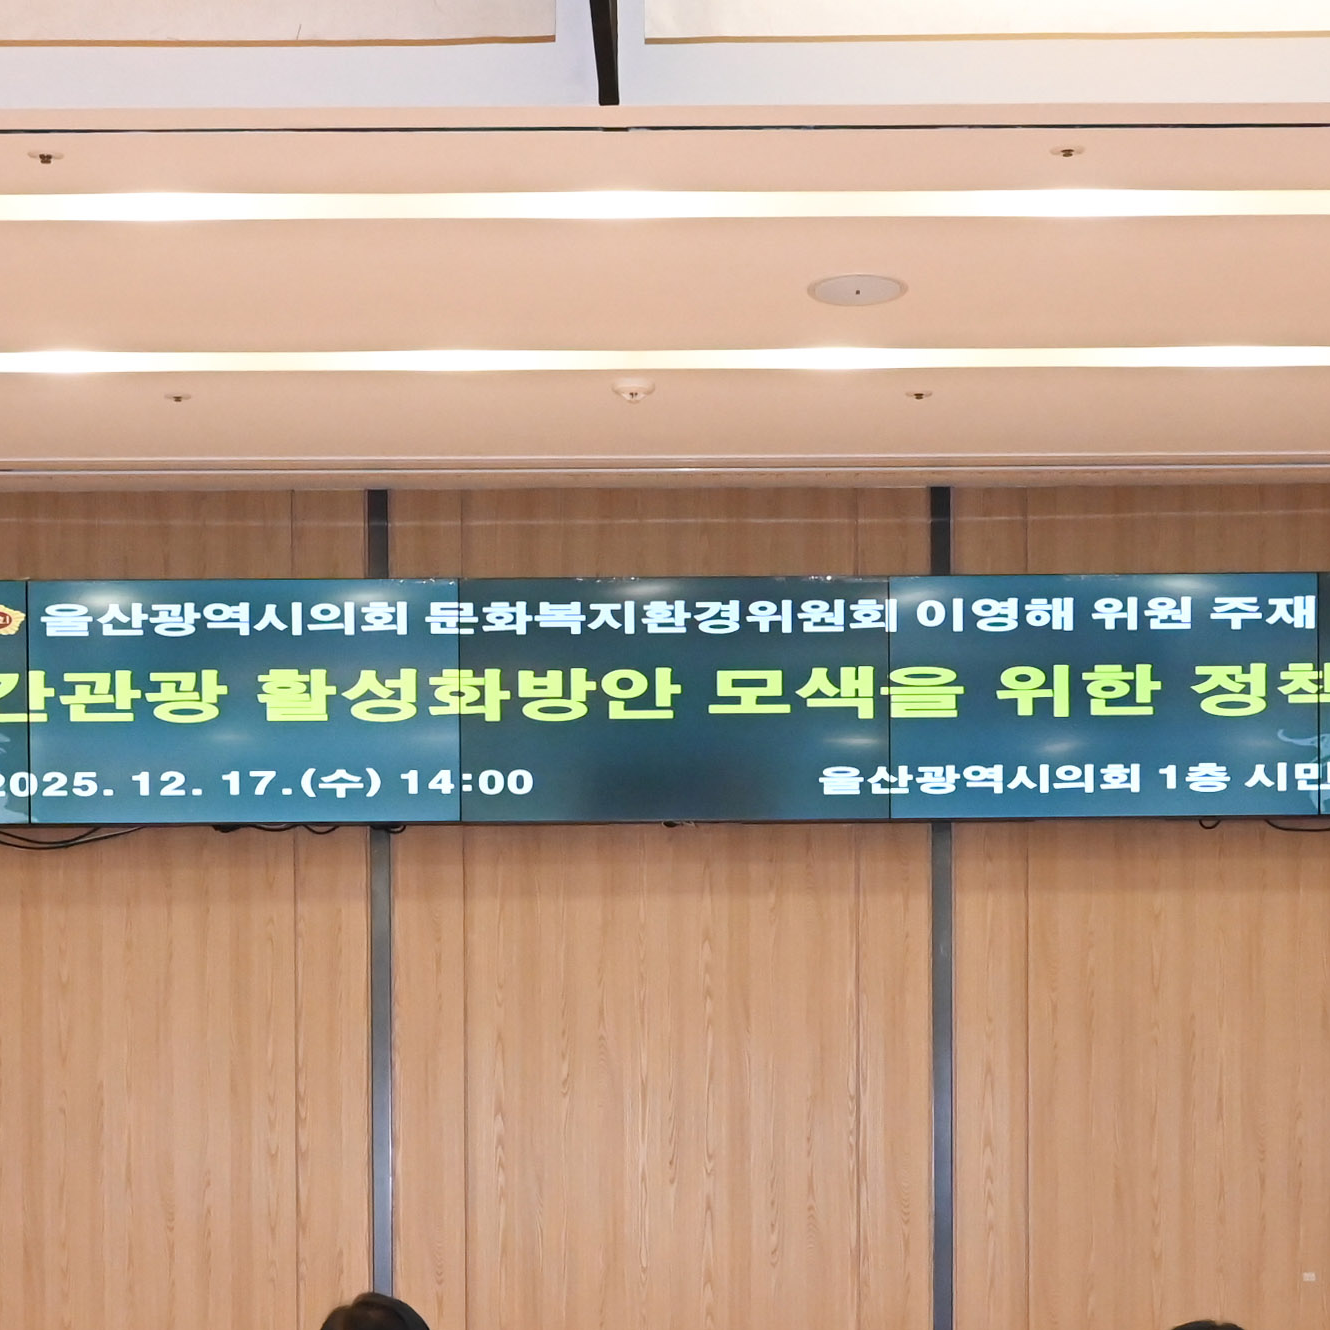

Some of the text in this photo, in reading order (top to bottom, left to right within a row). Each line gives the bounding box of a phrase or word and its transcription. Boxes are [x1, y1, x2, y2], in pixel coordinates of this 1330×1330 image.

[40, 595, 1316, 637] 울산광역시의회 문화복지환경위원회 이영해 위원 주재
[259, 666, 682, 723] 활성화방안
[707, 664, 965, 720] 모색을
[996, 662, 1162, 718] 위한
[131, 771, 203, 796] 12.
[222, 767, 381, 799] 17.(수)
[400, 769, 533, 795] 14:00
[818, 763, 1141, 796] 울산광역시의회
[1158, 762, 1232, 794] 1층
